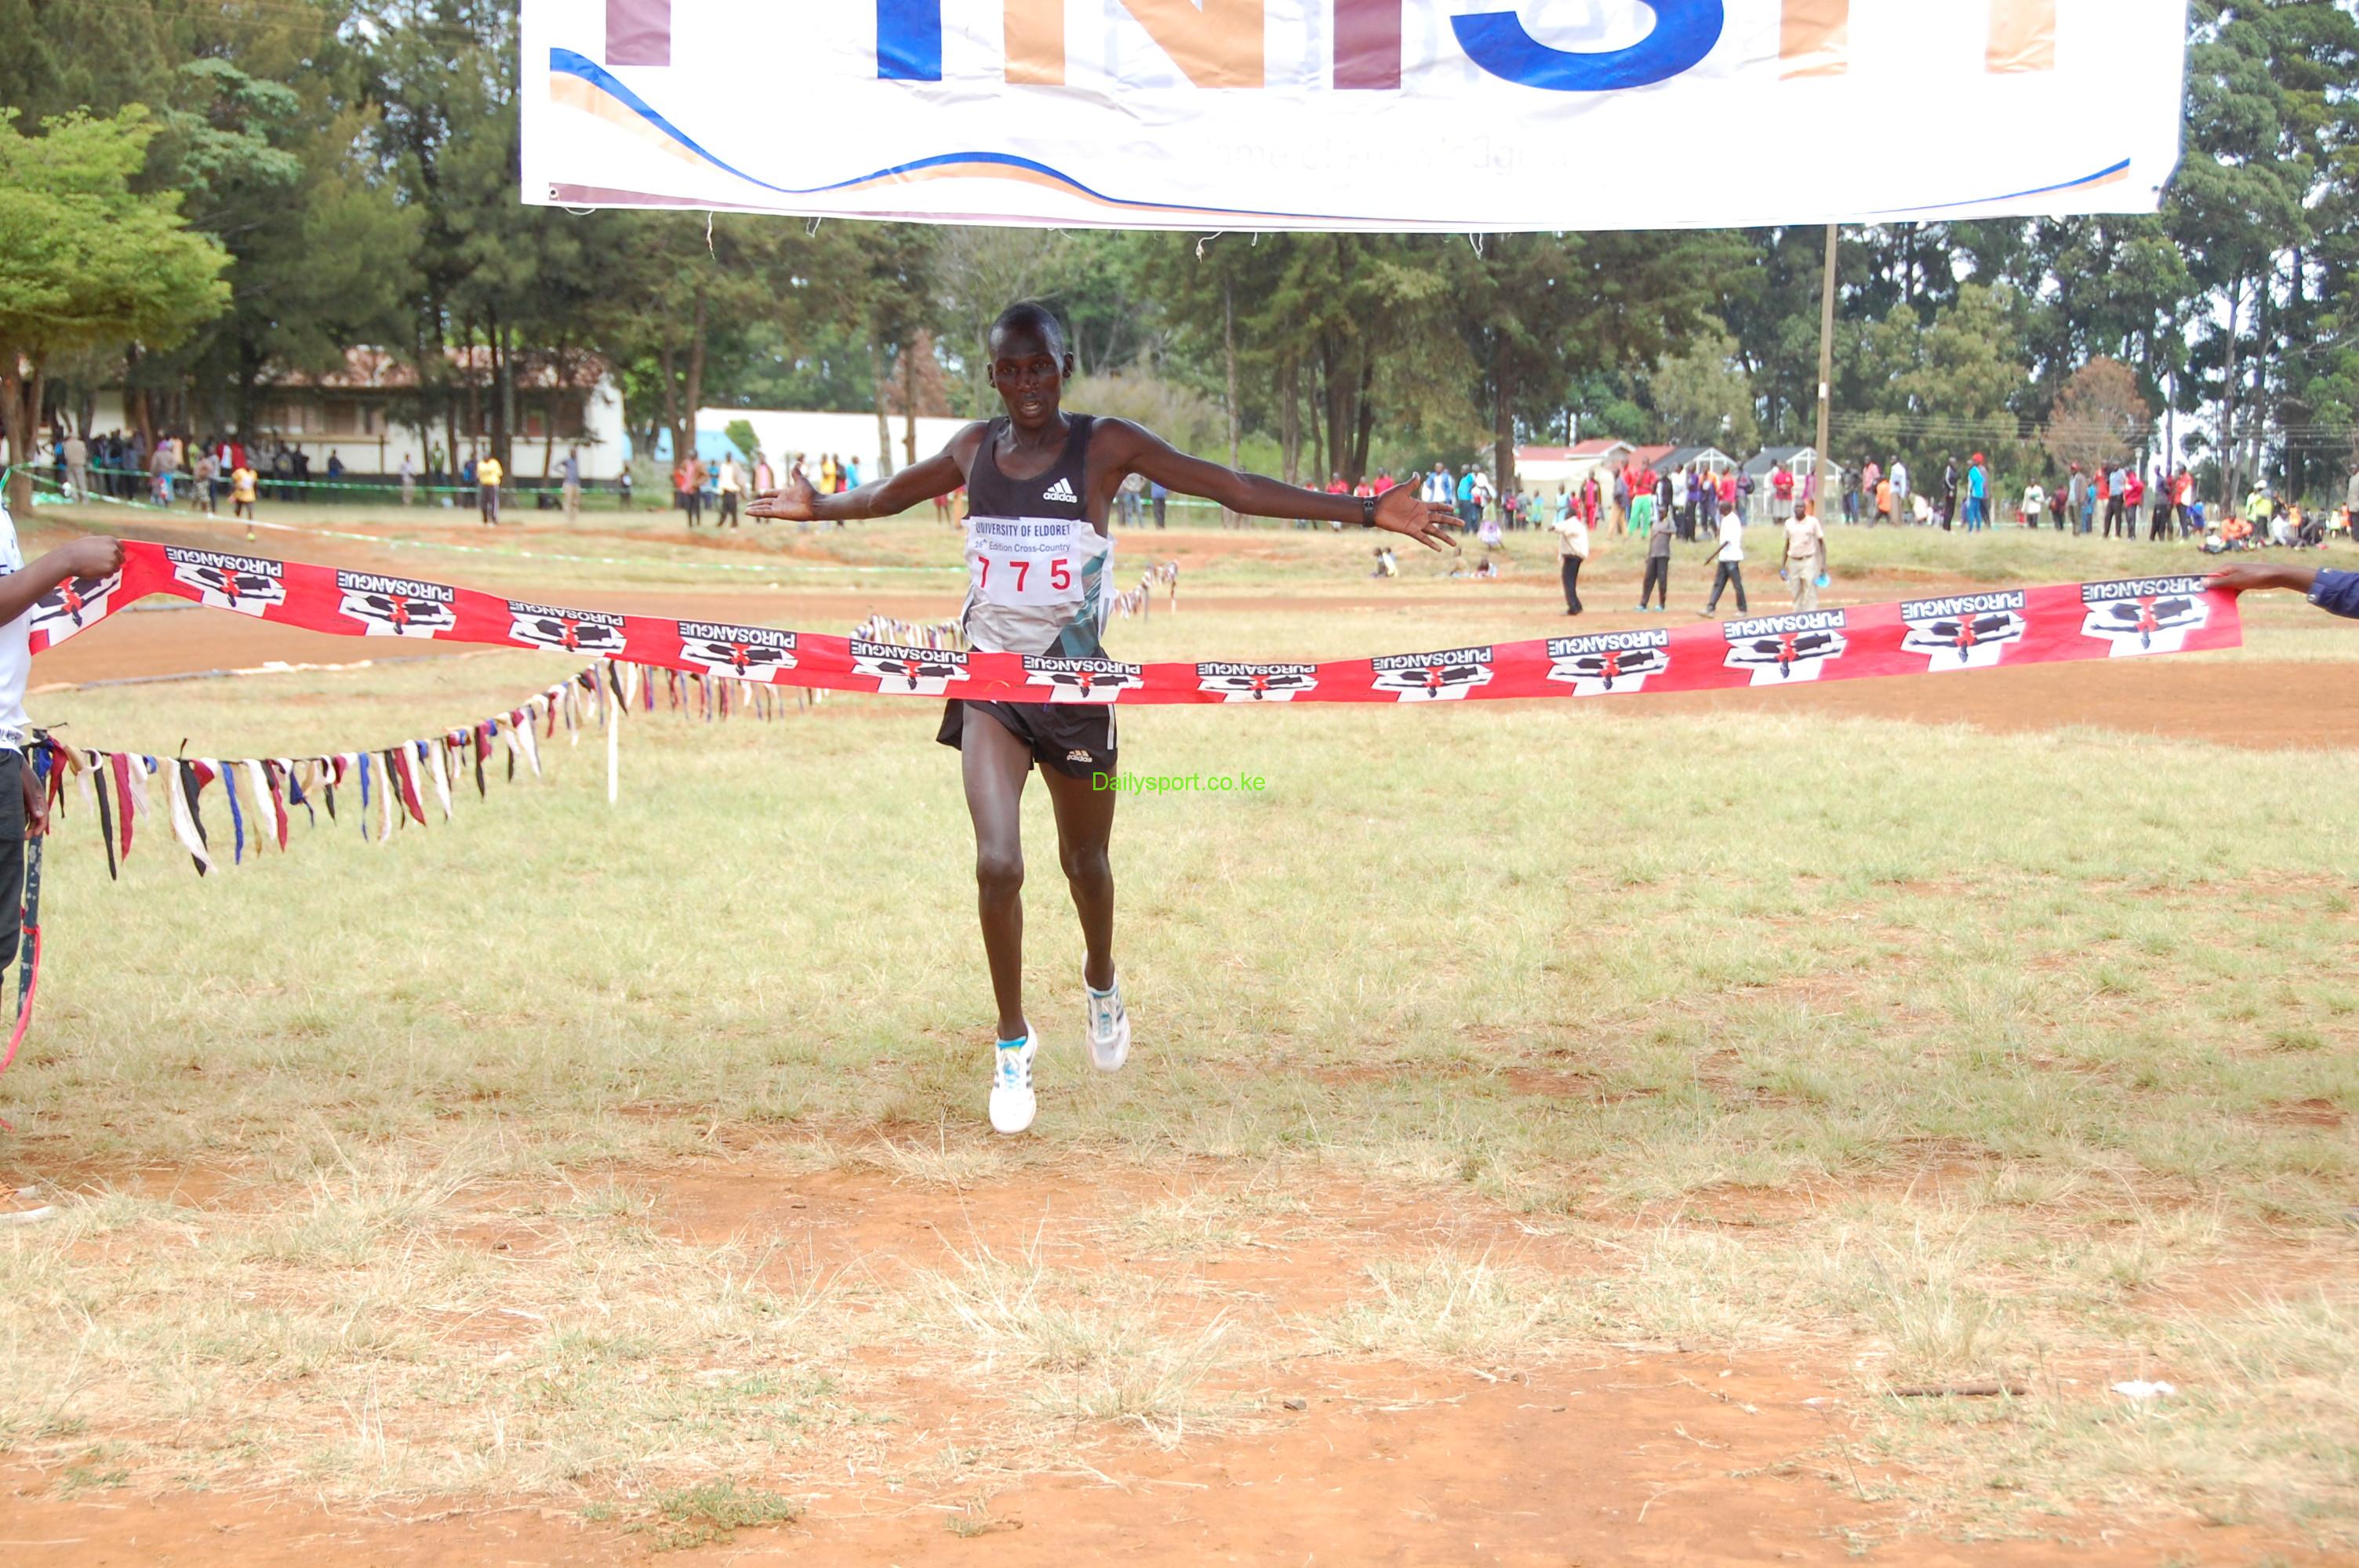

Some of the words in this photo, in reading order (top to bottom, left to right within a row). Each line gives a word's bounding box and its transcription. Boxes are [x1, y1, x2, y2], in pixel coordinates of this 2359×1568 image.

[1042, 491, 1078, 503] adidas
[976, 522, 1018, 536] UNIVERSITY
[1021, 524, 1031, 537] OF
[1034, 524, 1070, 536] ELDORET
[989, 542, 1012, 553] Edition
[1014, 543, 1070, 553] Cross-Country
[166, 547, 282, 578] PUROSANGUE
[339, 572, 453, 601] PUROSANGUE
[509, 601, 623, 626] PUROSANGUE
[1902, 591, 2023, 619] PUROSANGUE
[680, 622, 796, 649] PUROSANGUE
[1725, 612, 1845, 639] PUROSANGUE
[852, 640, 968, 663] PUROSANGUE
[1549, 630, 1668, 656] PUROSANGUE
[1024, 656, 1141, 675] PUROSANGUE
[1198, 663, 1317, 675] PUROSANGUE
[1373, 648, 1491, 669] PUROSANGUE
